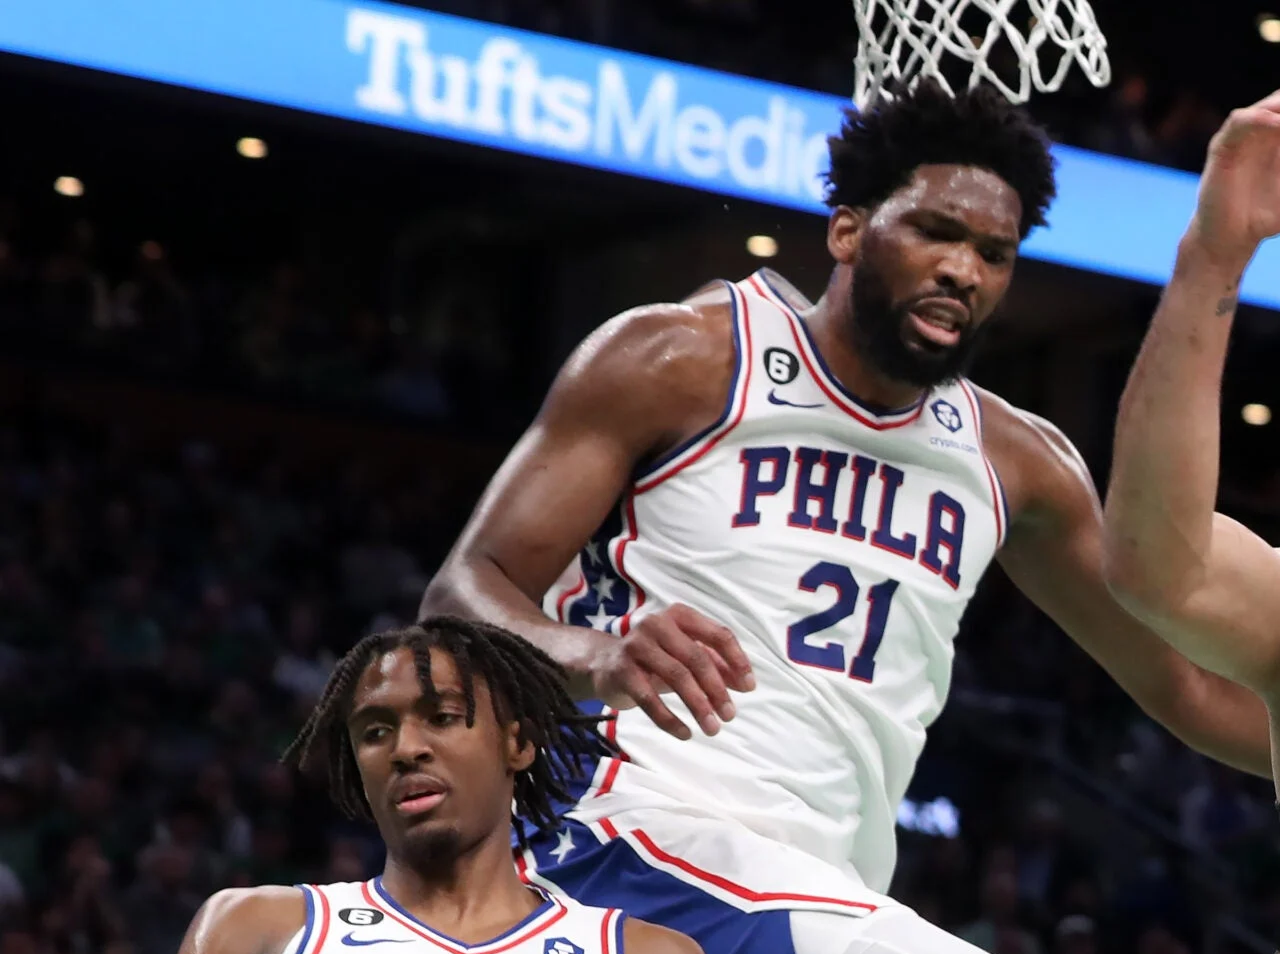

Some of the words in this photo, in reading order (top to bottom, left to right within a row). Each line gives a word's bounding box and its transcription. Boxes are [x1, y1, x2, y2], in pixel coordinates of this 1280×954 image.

[769, 351, 789, 379] 6
[732, 446, 965, 591] PHILA
[787, 561, 899, 684] 21
[347, 909, 374, 925] 6
